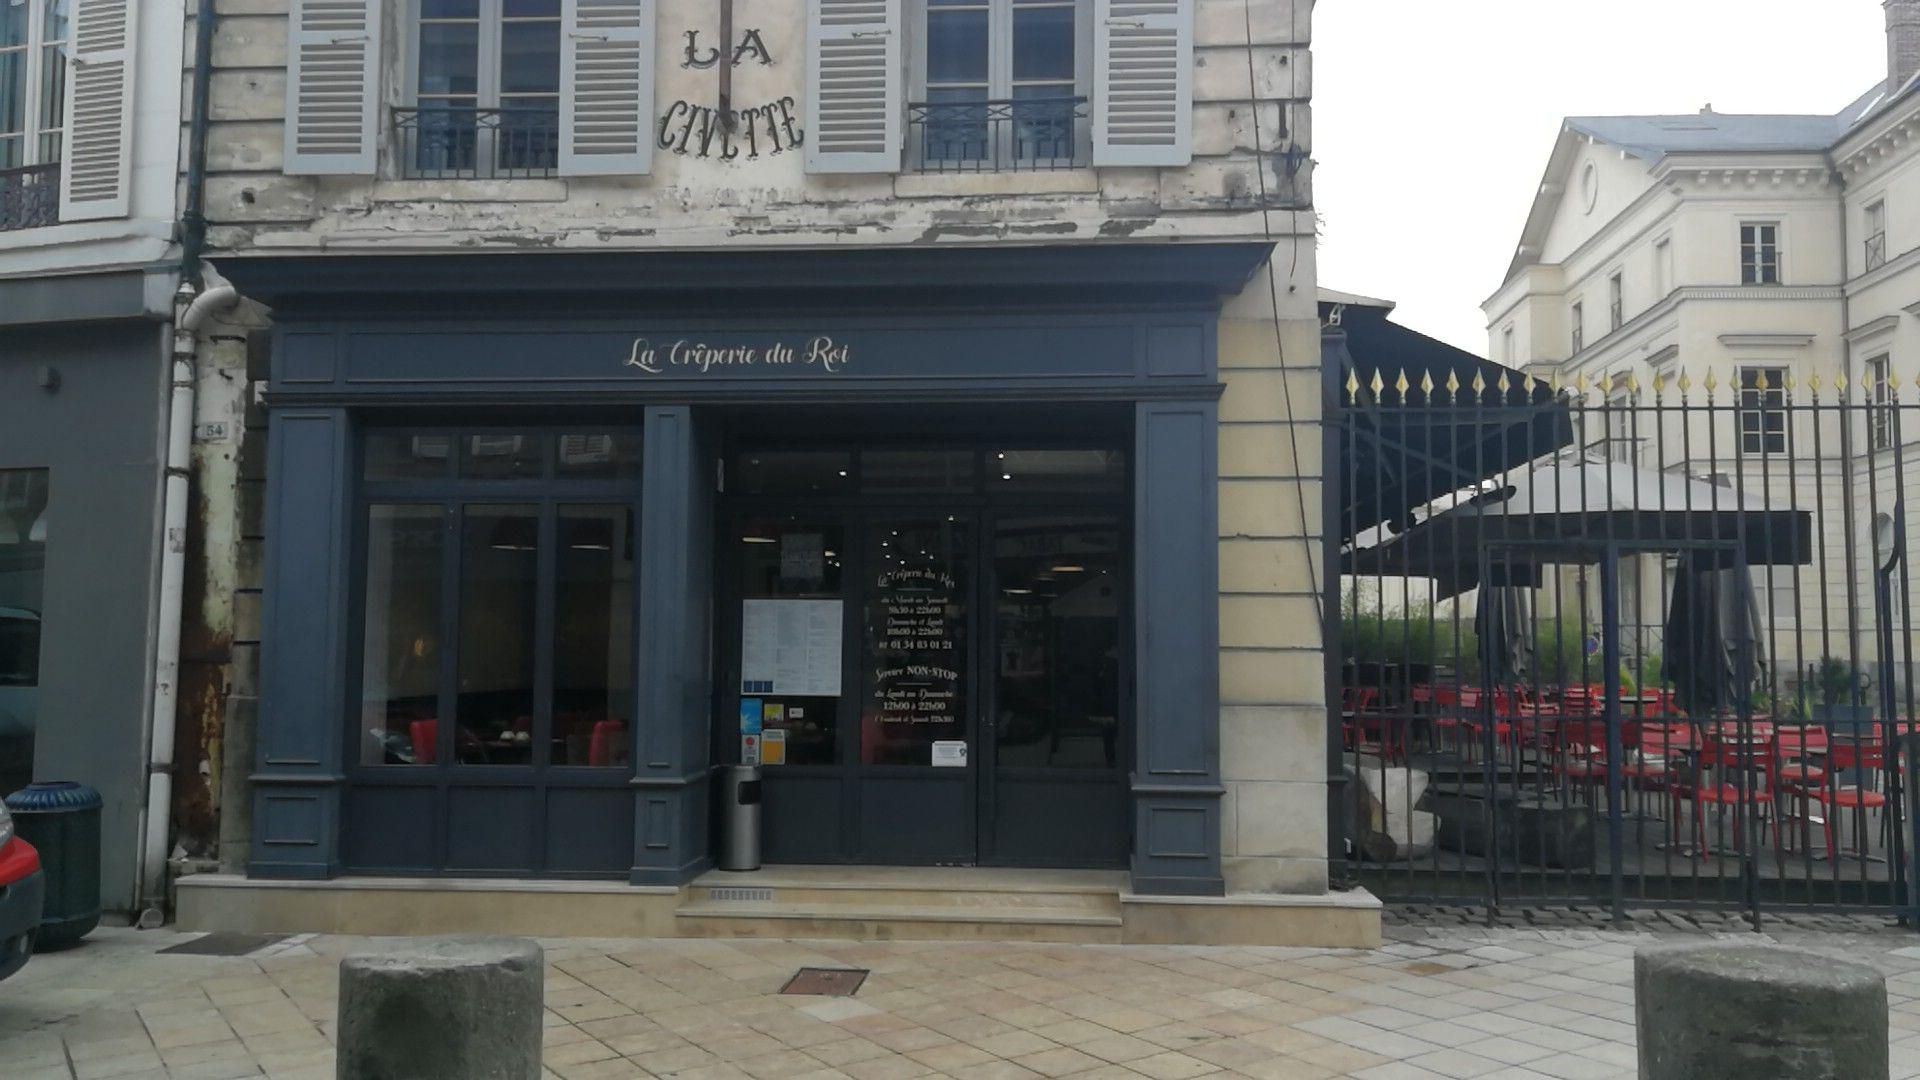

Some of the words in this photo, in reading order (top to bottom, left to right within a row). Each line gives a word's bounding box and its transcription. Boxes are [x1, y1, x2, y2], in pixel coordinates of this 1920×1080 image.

[681, 29, 774, 69] LA
[657, 97, 804, 161] CIVETTE
[623, 338, 663, 373] La
[660, 340, 757, 373] Crêperie
[765, 342, 794, 364] du
[802, 336, 849, 373] Roi
[890, 640, 902, 649] 01
[929, 640, 940, 649] 01
[941, 640, 953, 649] 21
[906, 665, 958, 681] NON-STOP
[883, 702, 910, 711] 12h00
[917, 702, 946, 711] 22h00
